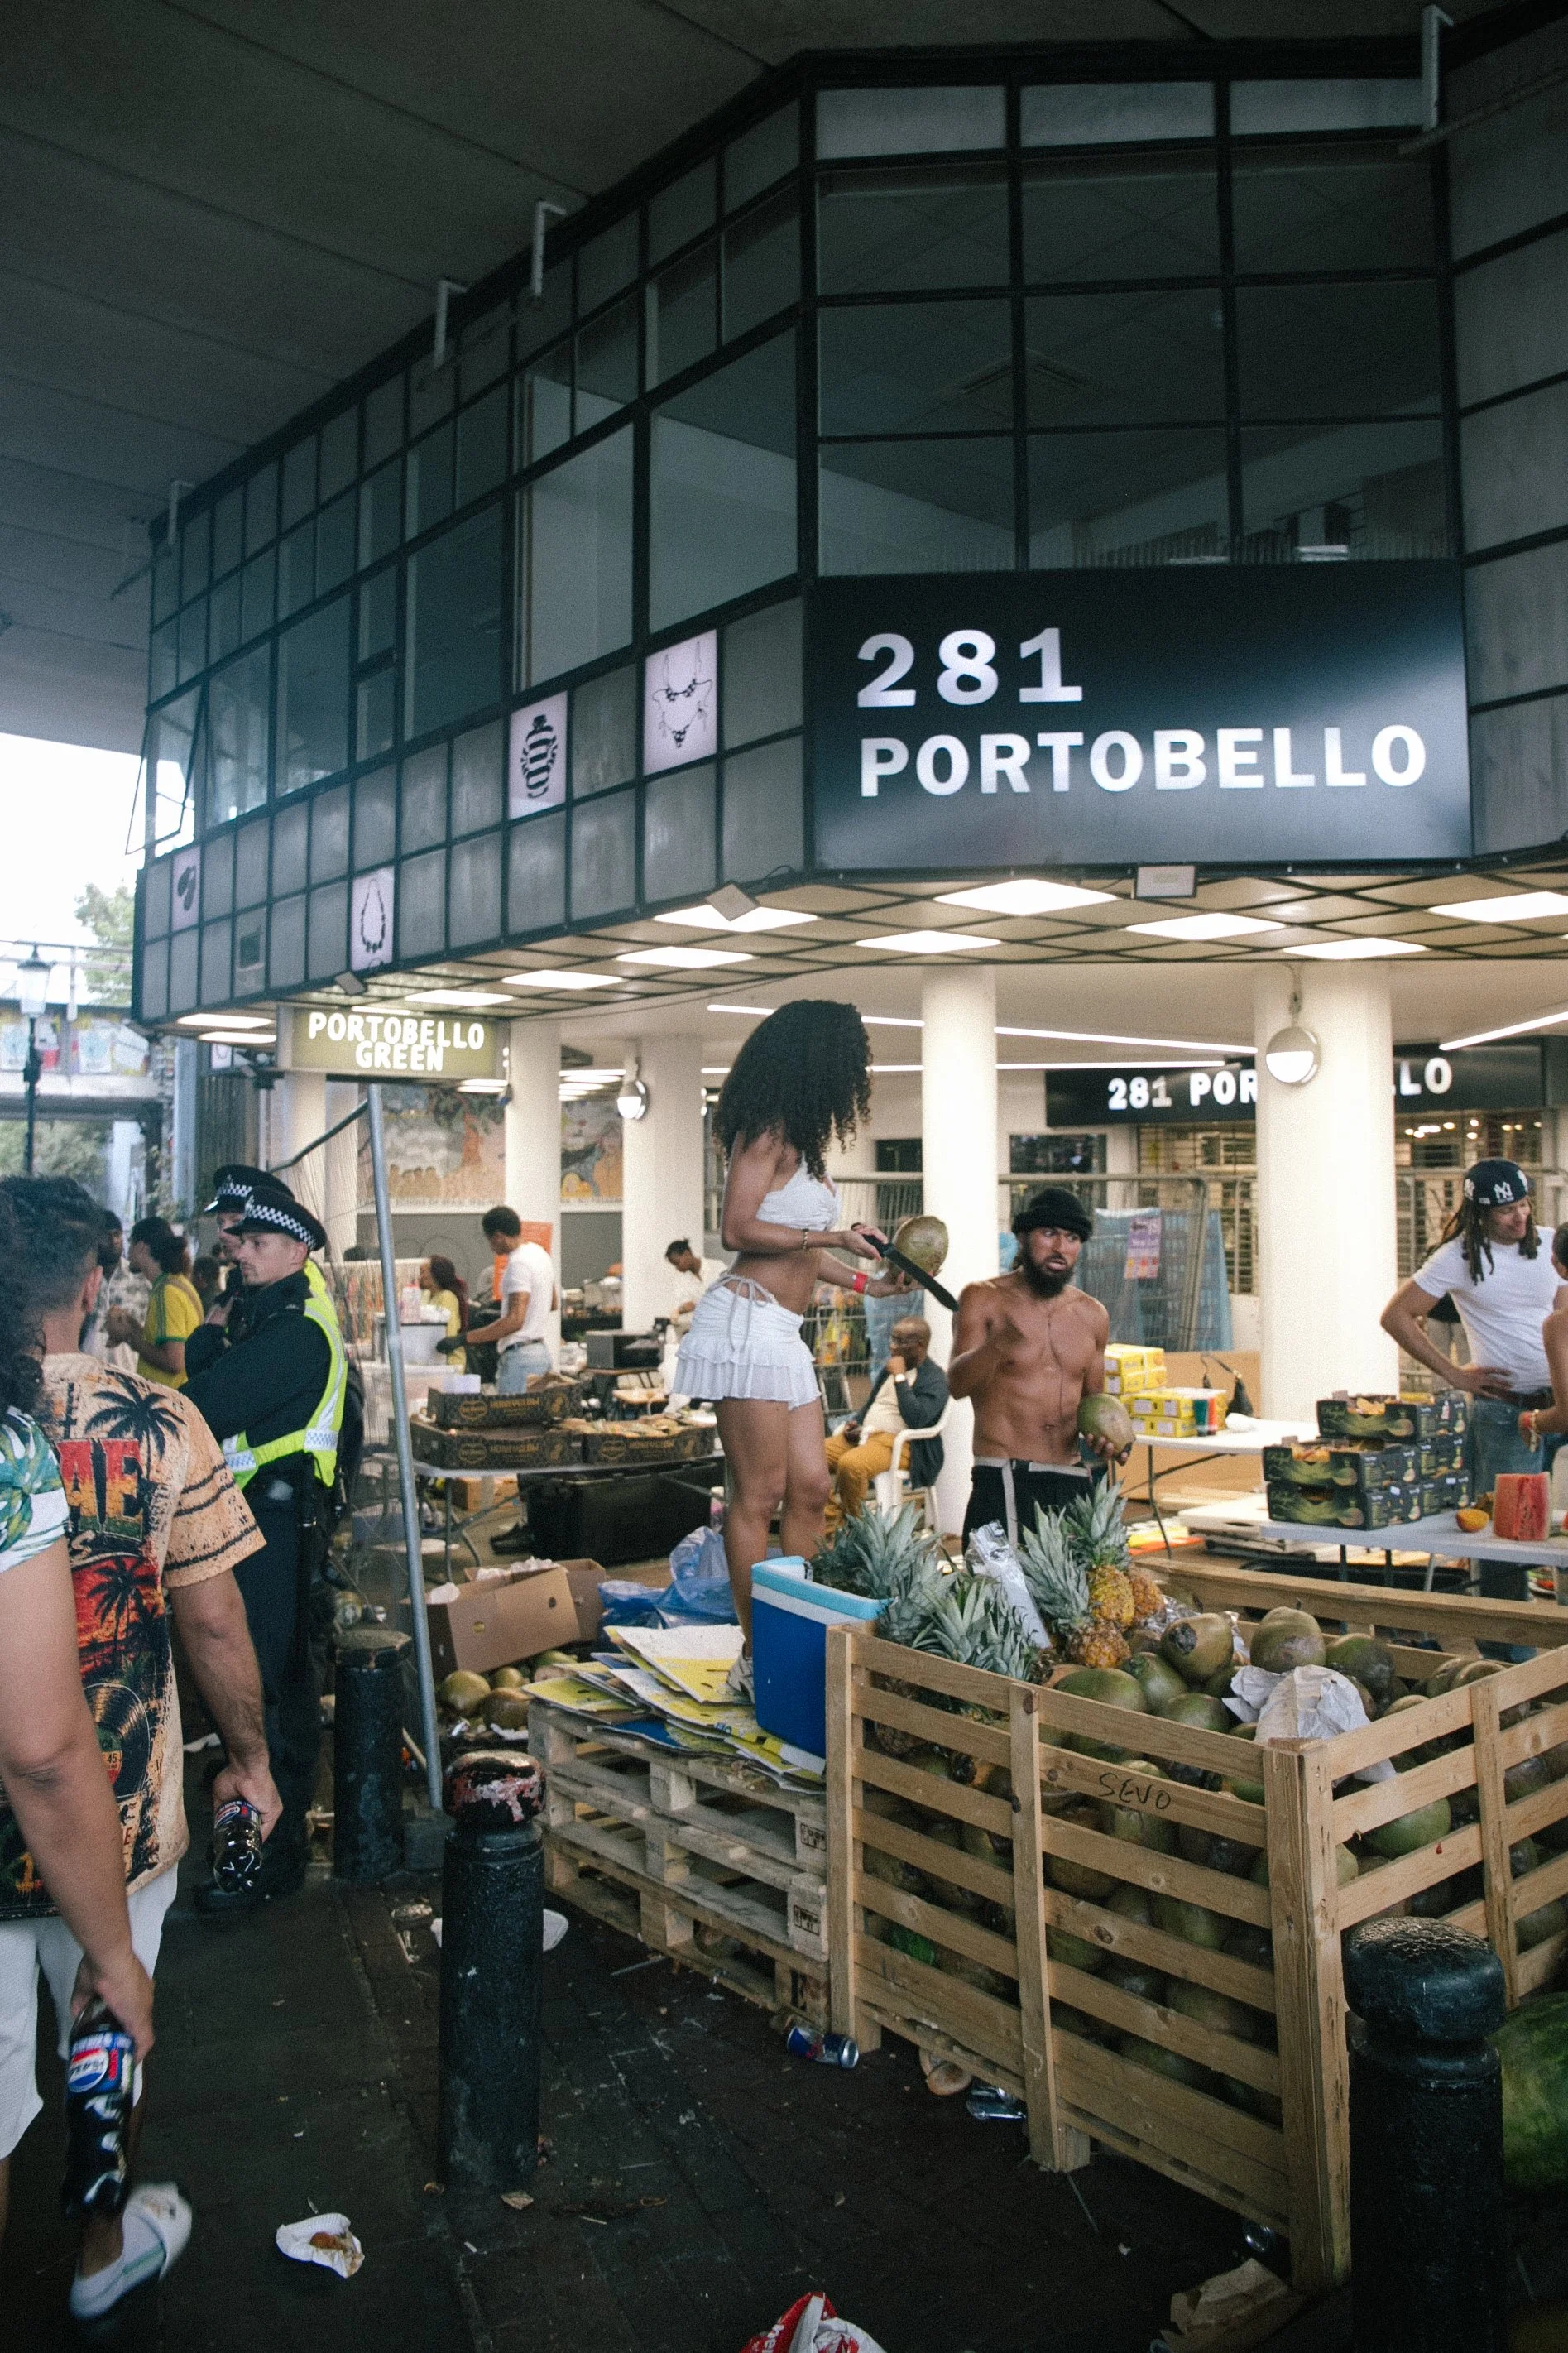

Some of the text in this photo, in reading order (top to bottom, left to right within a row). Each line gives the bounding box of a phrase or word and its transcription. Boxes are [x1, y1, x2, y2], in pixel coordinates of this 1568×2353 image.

[857, 627, 1083, 708] 281
[861, 724, 1427, 797] PORTOBELLO
[309, 1011, 485, 1050] PORTOBELLO
[355, 1040, 444, 1071] GREEN
[1107, 1076, 1172, 1110] 281
[1098, 1772, 1172, 1811] SEVO
